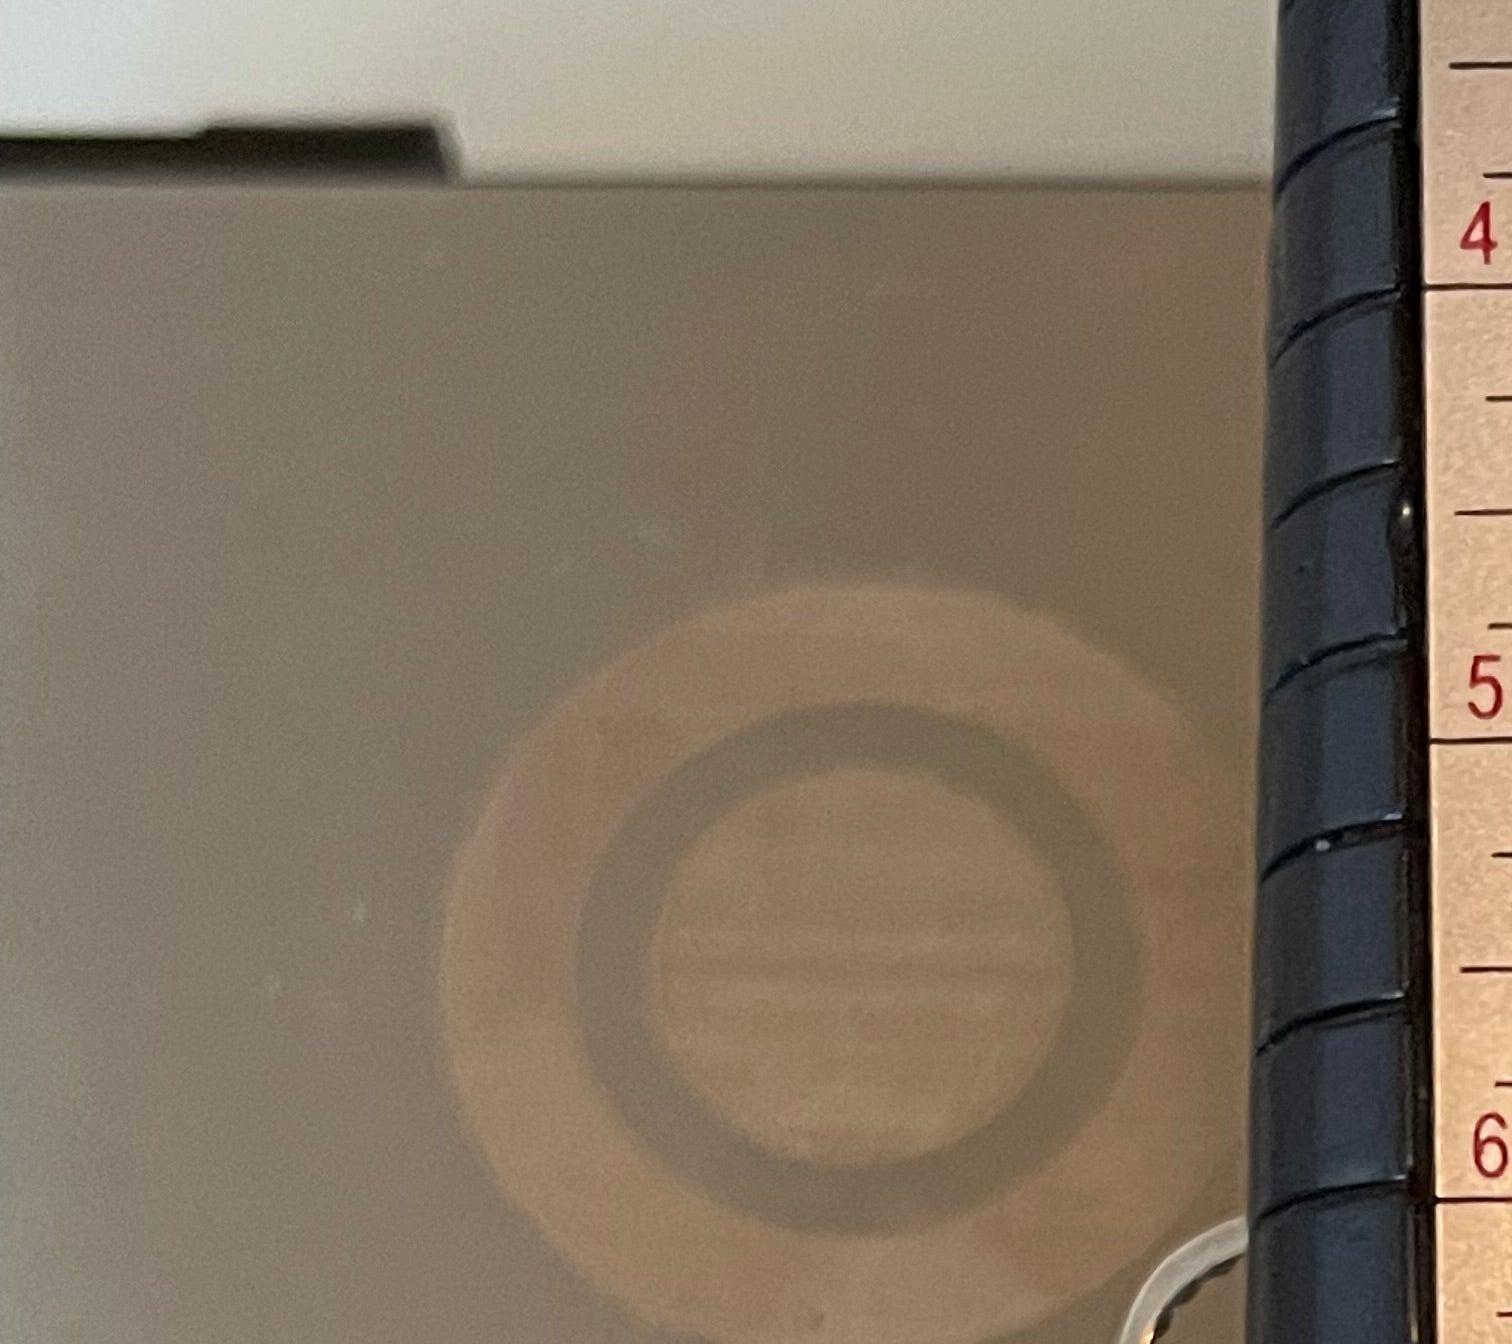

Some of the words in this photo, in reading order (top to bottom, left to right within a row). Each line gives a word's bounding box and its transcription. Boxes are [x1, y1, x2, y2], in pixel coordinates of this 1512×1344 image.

[1459, 201, 1498, 265] 4
[1468, 654, 1503, 719] 5
[1472, 1112, 1508, 1178] 6
